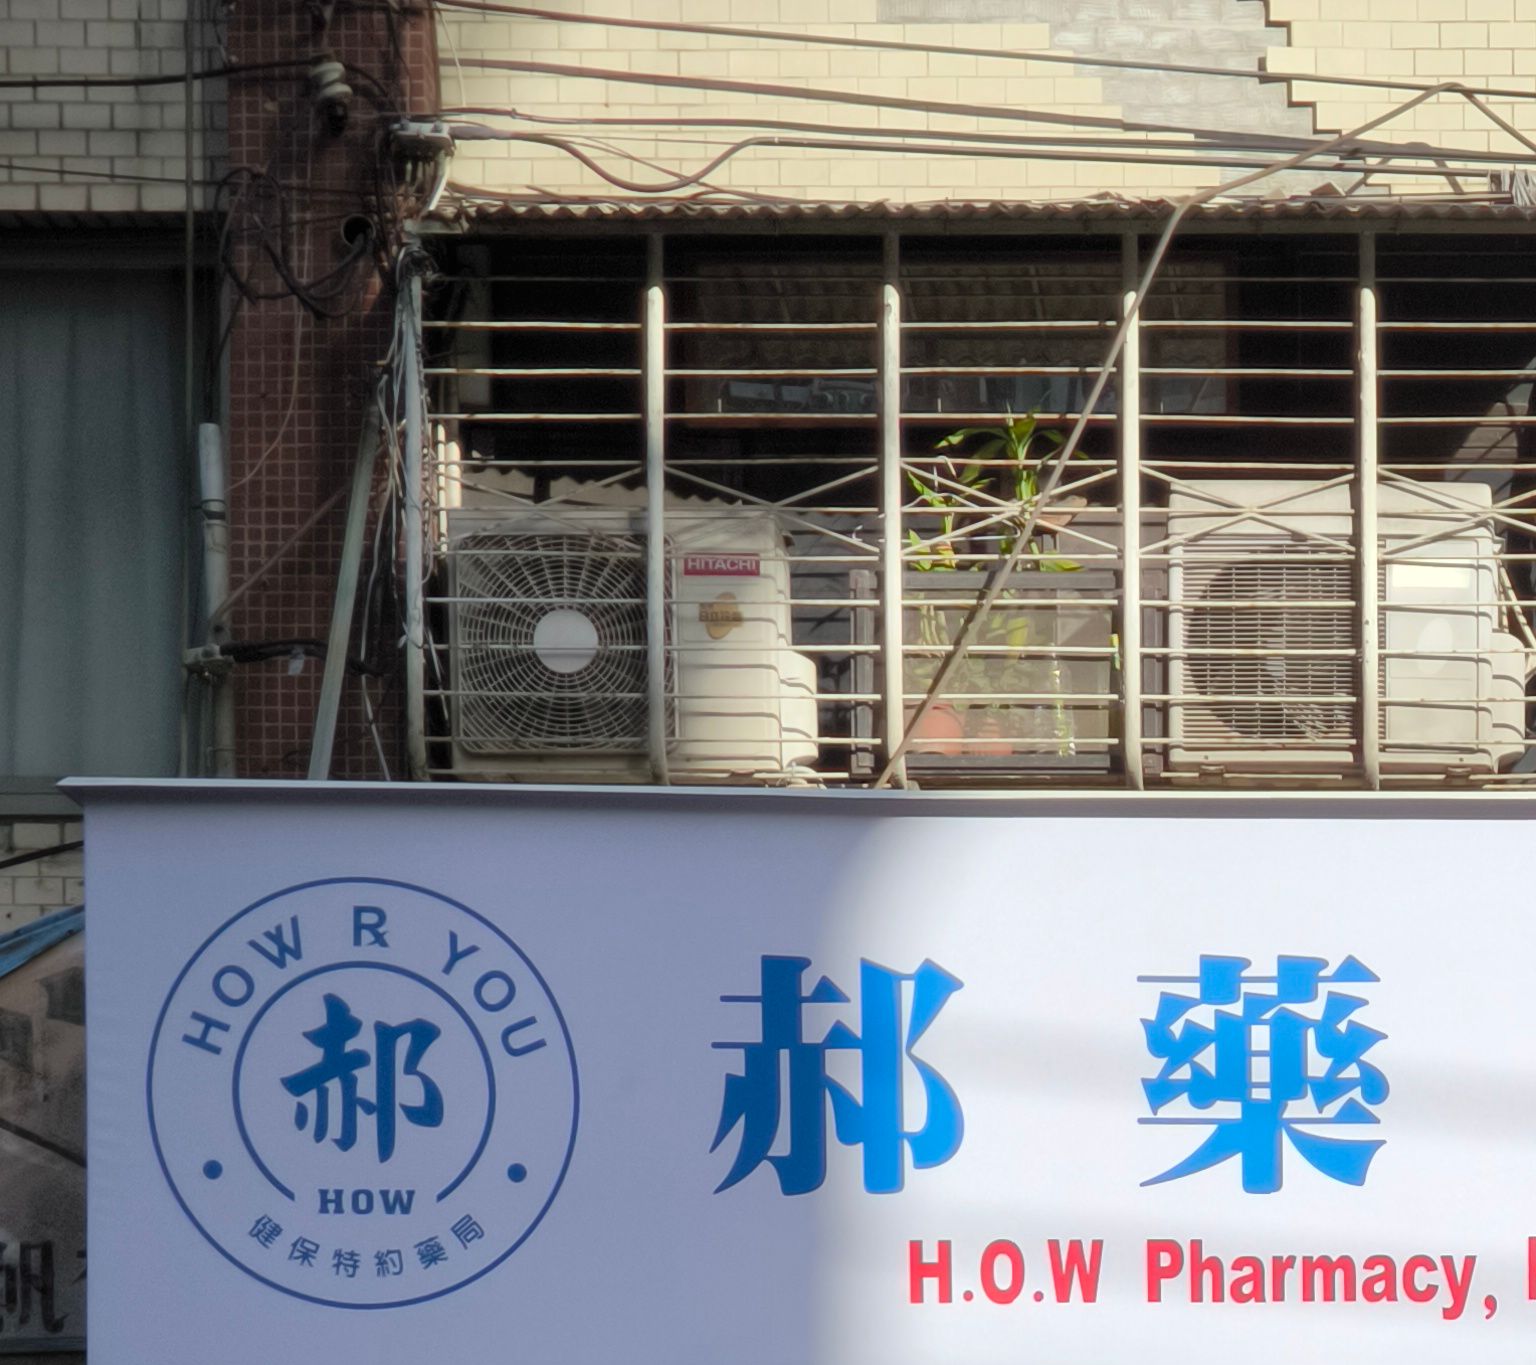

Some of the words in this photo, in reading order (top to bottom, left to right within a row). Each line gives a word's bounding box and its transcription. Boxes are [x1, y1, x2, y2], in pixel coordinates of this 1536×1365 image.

[687, 558, 757, 571] HITACHI
[181, 914, 304, 1056] HOW
[440, 929, 548, 1058] YOU
[279, 992, 445, 1164] 郝
[317, 1188, 416, 1216] HOW
[248, 1213, 486, 1279] 健保特約藥局
[908, 1238, 1105, 1306] H.O.W
[1144, 1237, 1500, 1322] Pharmacy,
